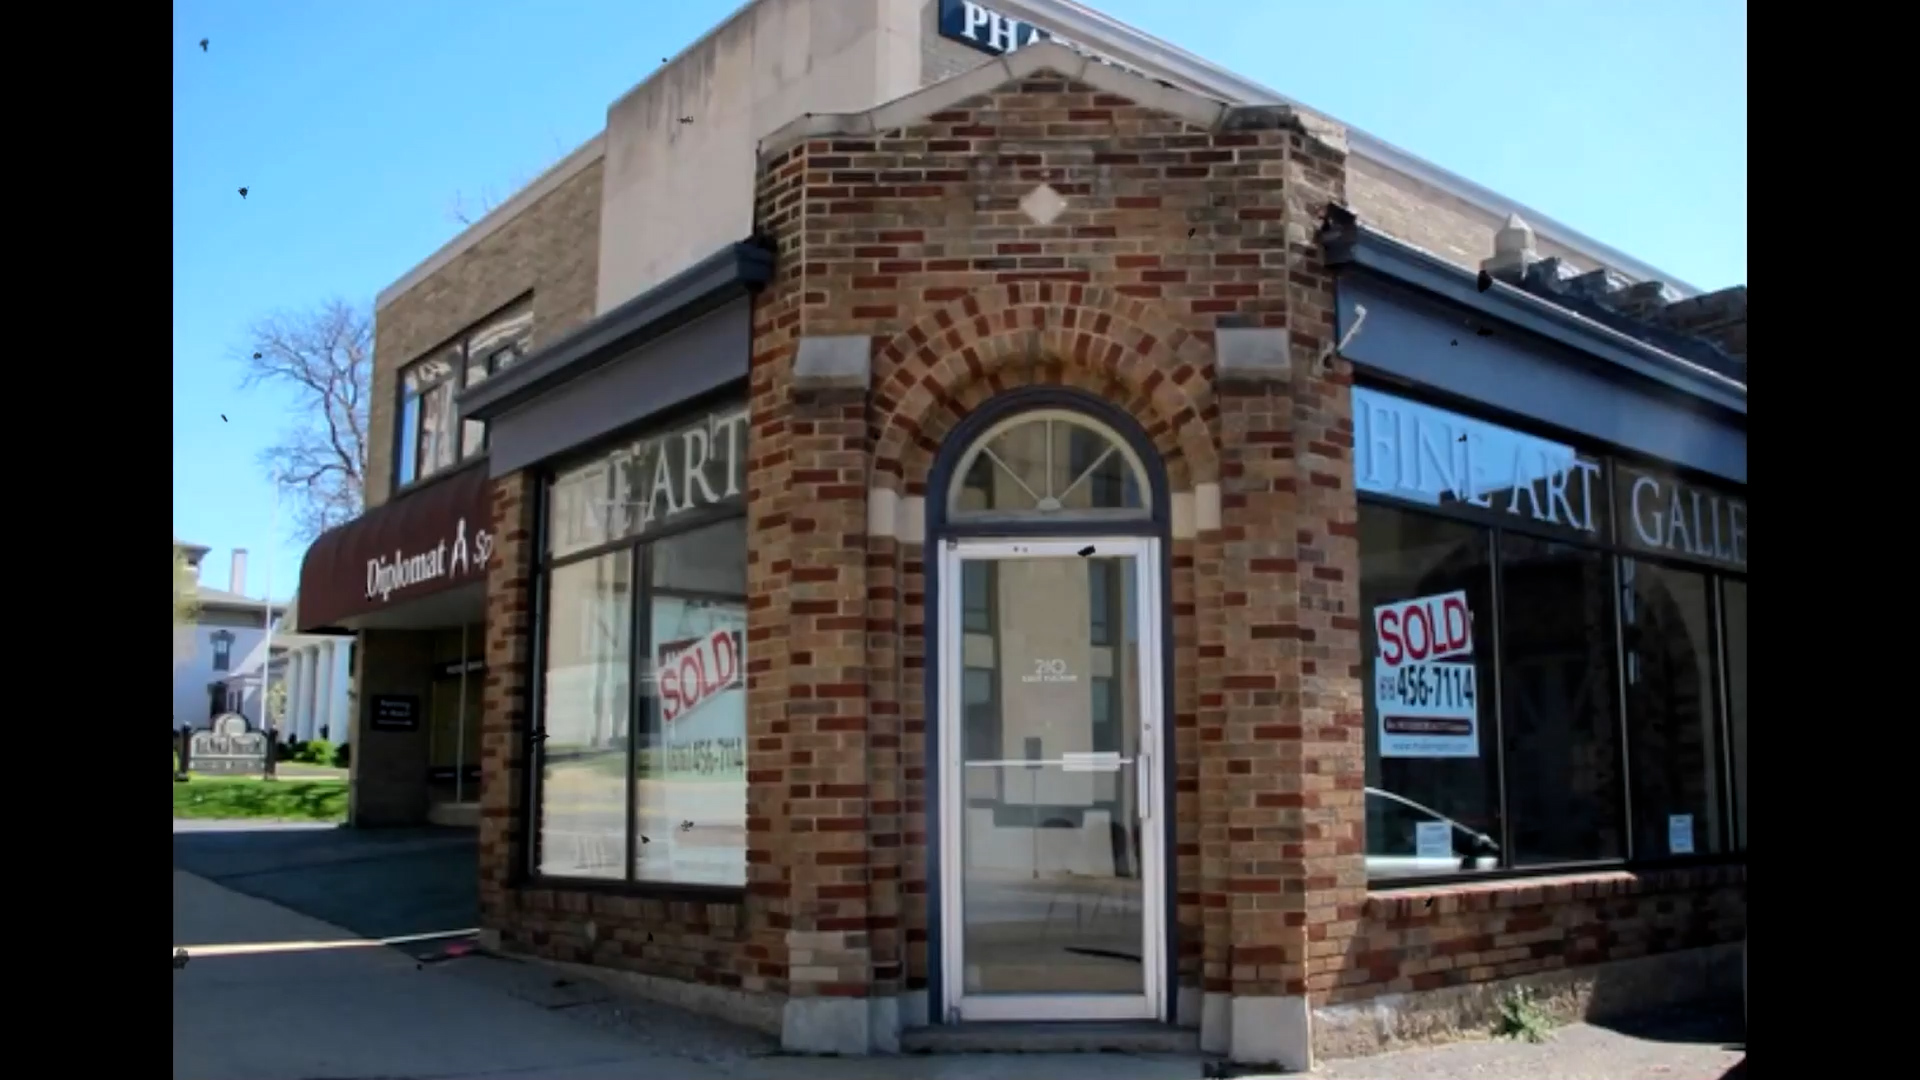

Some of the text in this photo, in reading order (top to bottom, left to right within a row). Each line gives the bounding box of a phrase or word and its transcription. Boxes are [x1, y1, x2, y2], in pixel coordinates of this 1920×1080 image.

[644, 410, 750, 523] ART
[1358, 398, 1492, 508] FINE
[1506, 444, 1600, 533] ART
[365, 537, 446, 602] Diplomat
[1379, 597, 1468, 667] SOLD
[660, 630, 735, 722] SOLD
[1397, 664, 1475, 709] 456-7114
